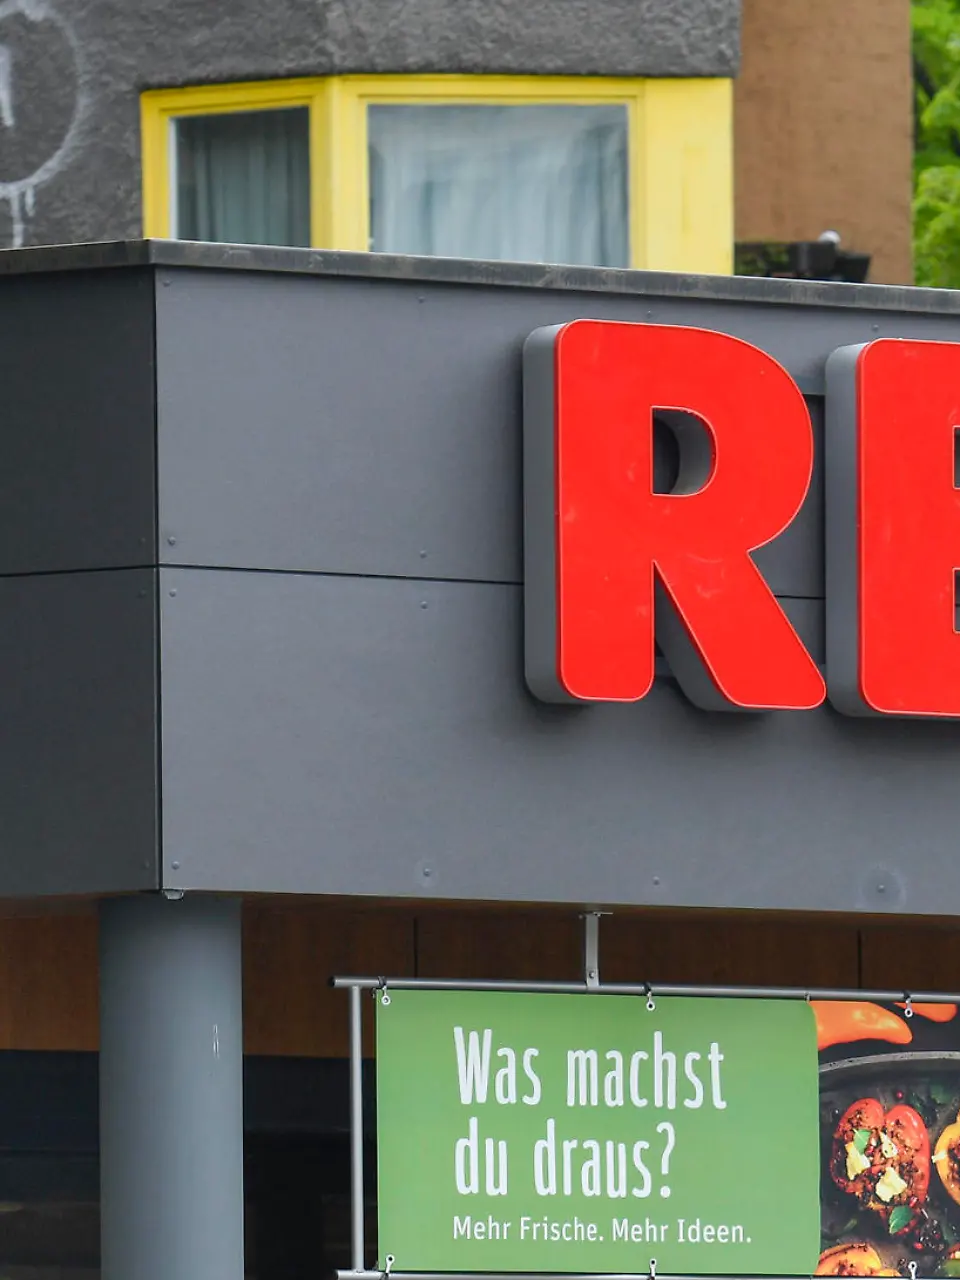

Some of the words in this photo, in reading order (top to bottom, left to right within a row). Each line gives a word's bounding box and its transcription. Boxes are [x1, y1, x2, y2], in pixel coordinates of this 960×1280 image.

[454, 1026, 541, 1105] Was
[567, 1031, 726, 1109] machst
[454, 1116, 508, 1196] du
[534, 1118, 675, 1198] draus?
[453, 1215, 511, 1240] Mehr
[519, 1216, 604, 1242] Frische.
[612, 1218, 669, 1242] Mehr
[677, 1219, 752, 1243] Ideen.
